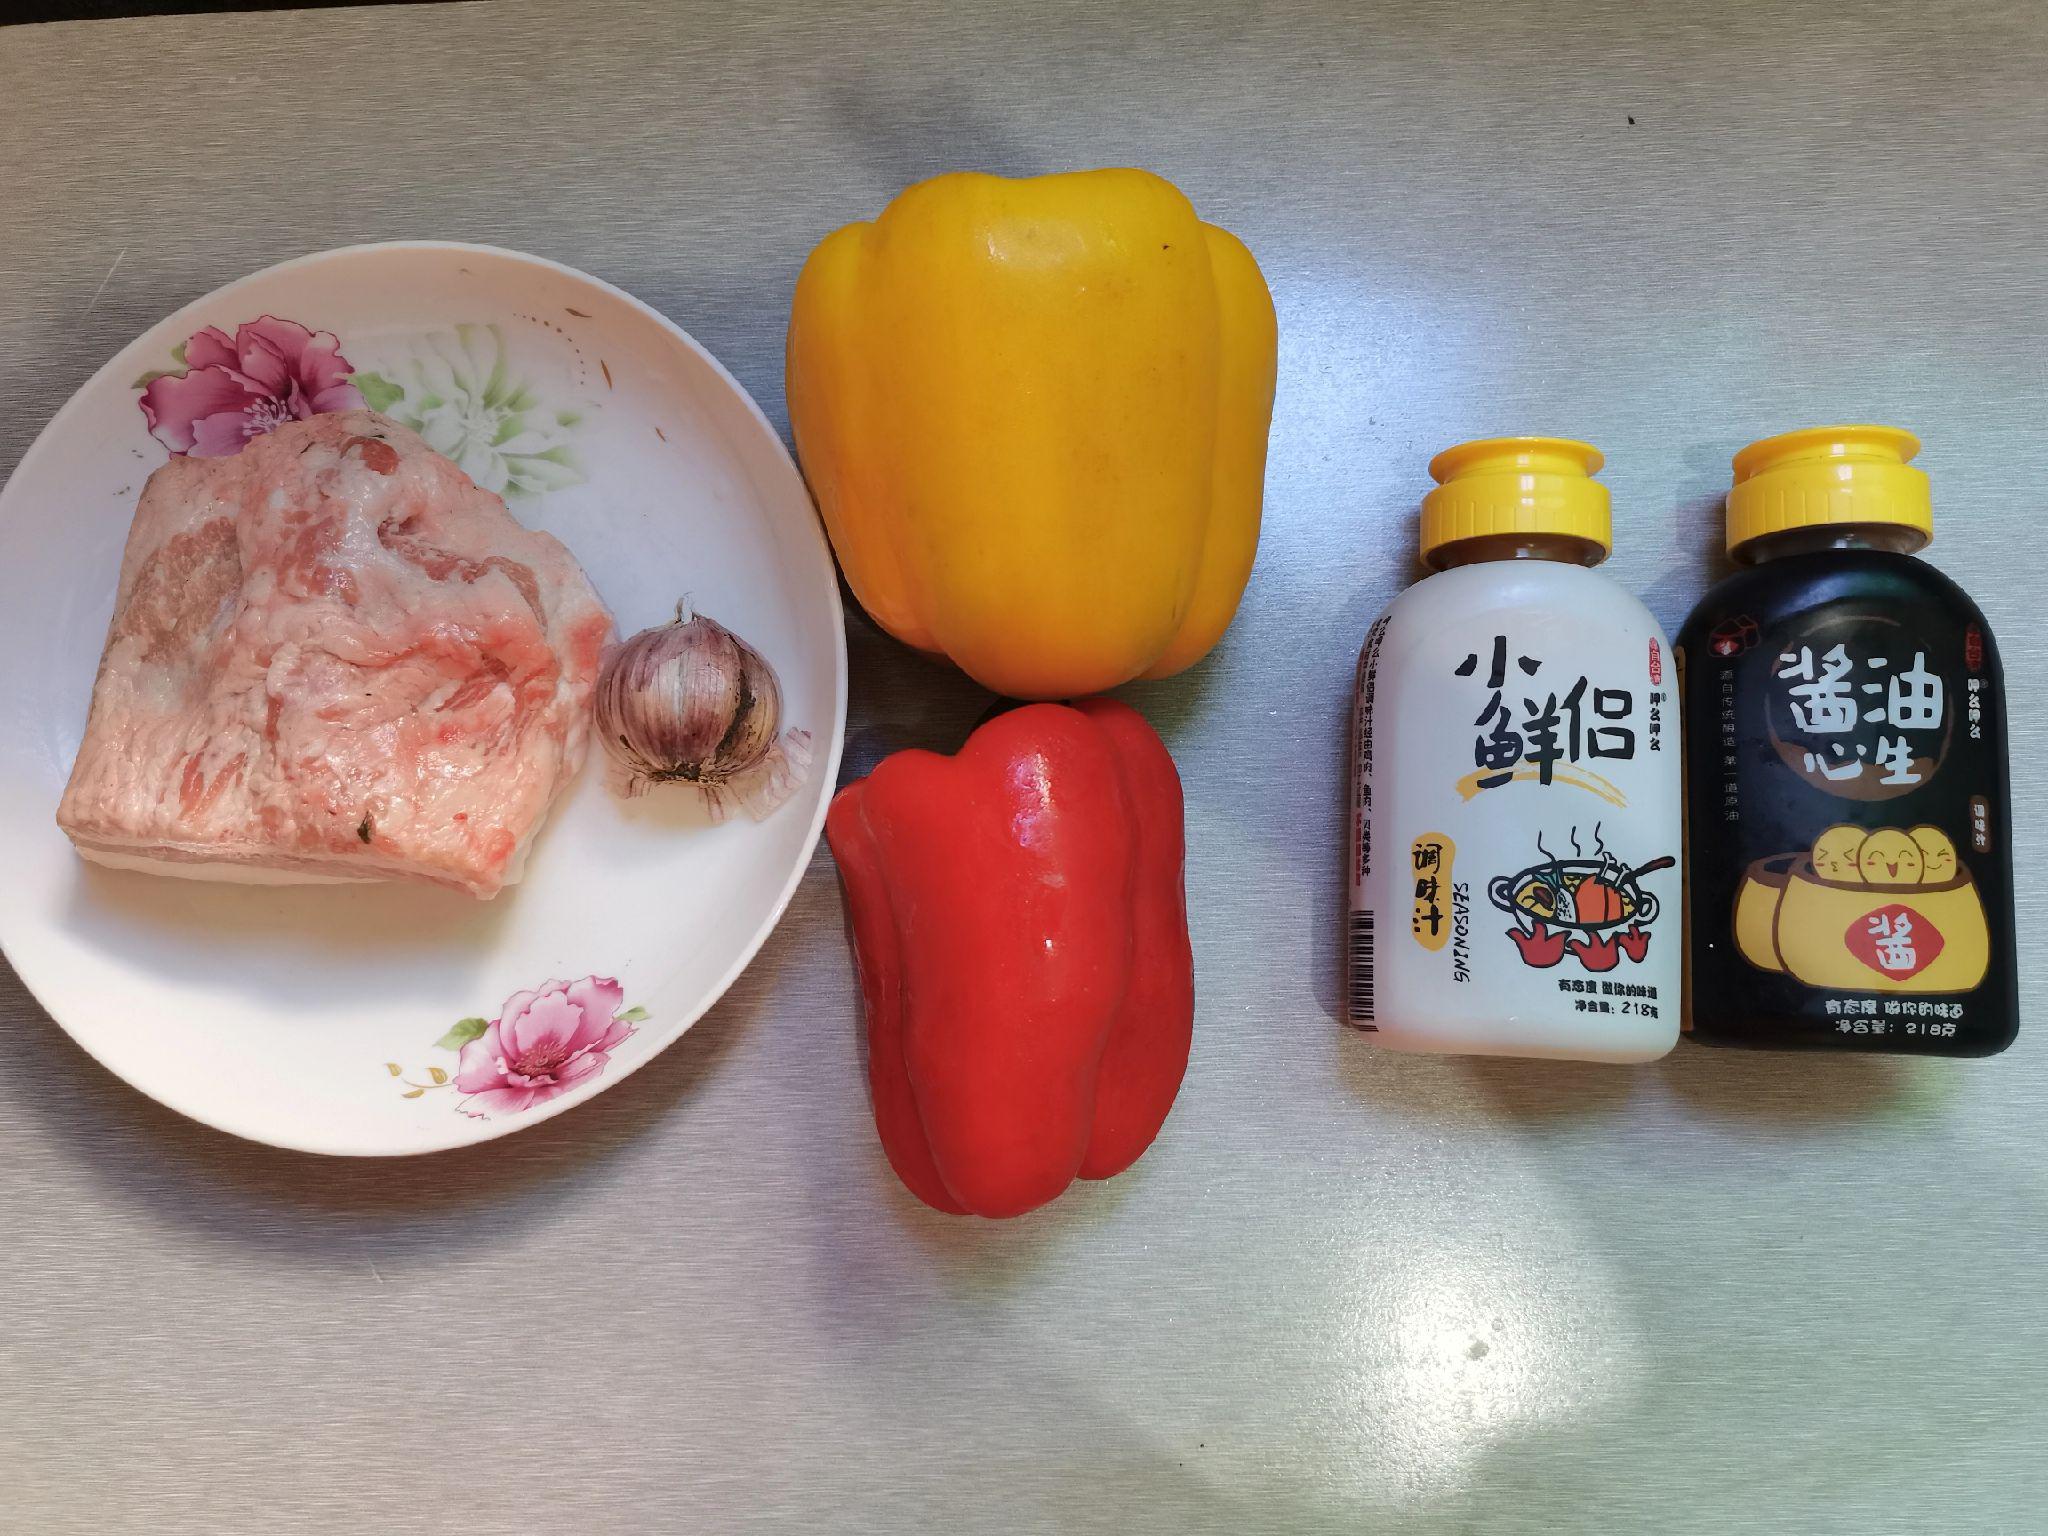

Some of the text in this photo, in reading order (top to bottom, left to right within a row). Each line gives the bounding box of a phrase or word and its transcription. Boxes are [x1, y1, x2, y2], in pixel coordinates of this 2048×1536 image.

[1778, 643, 1944, 734] 酱油
[1803, 735, 1922, 785] 心生
[1411, 843, 1443, 937] 调味汁
[1451, 882, 1471, 983] SEASONING
[1867, 912, 1917, 970] 酱
